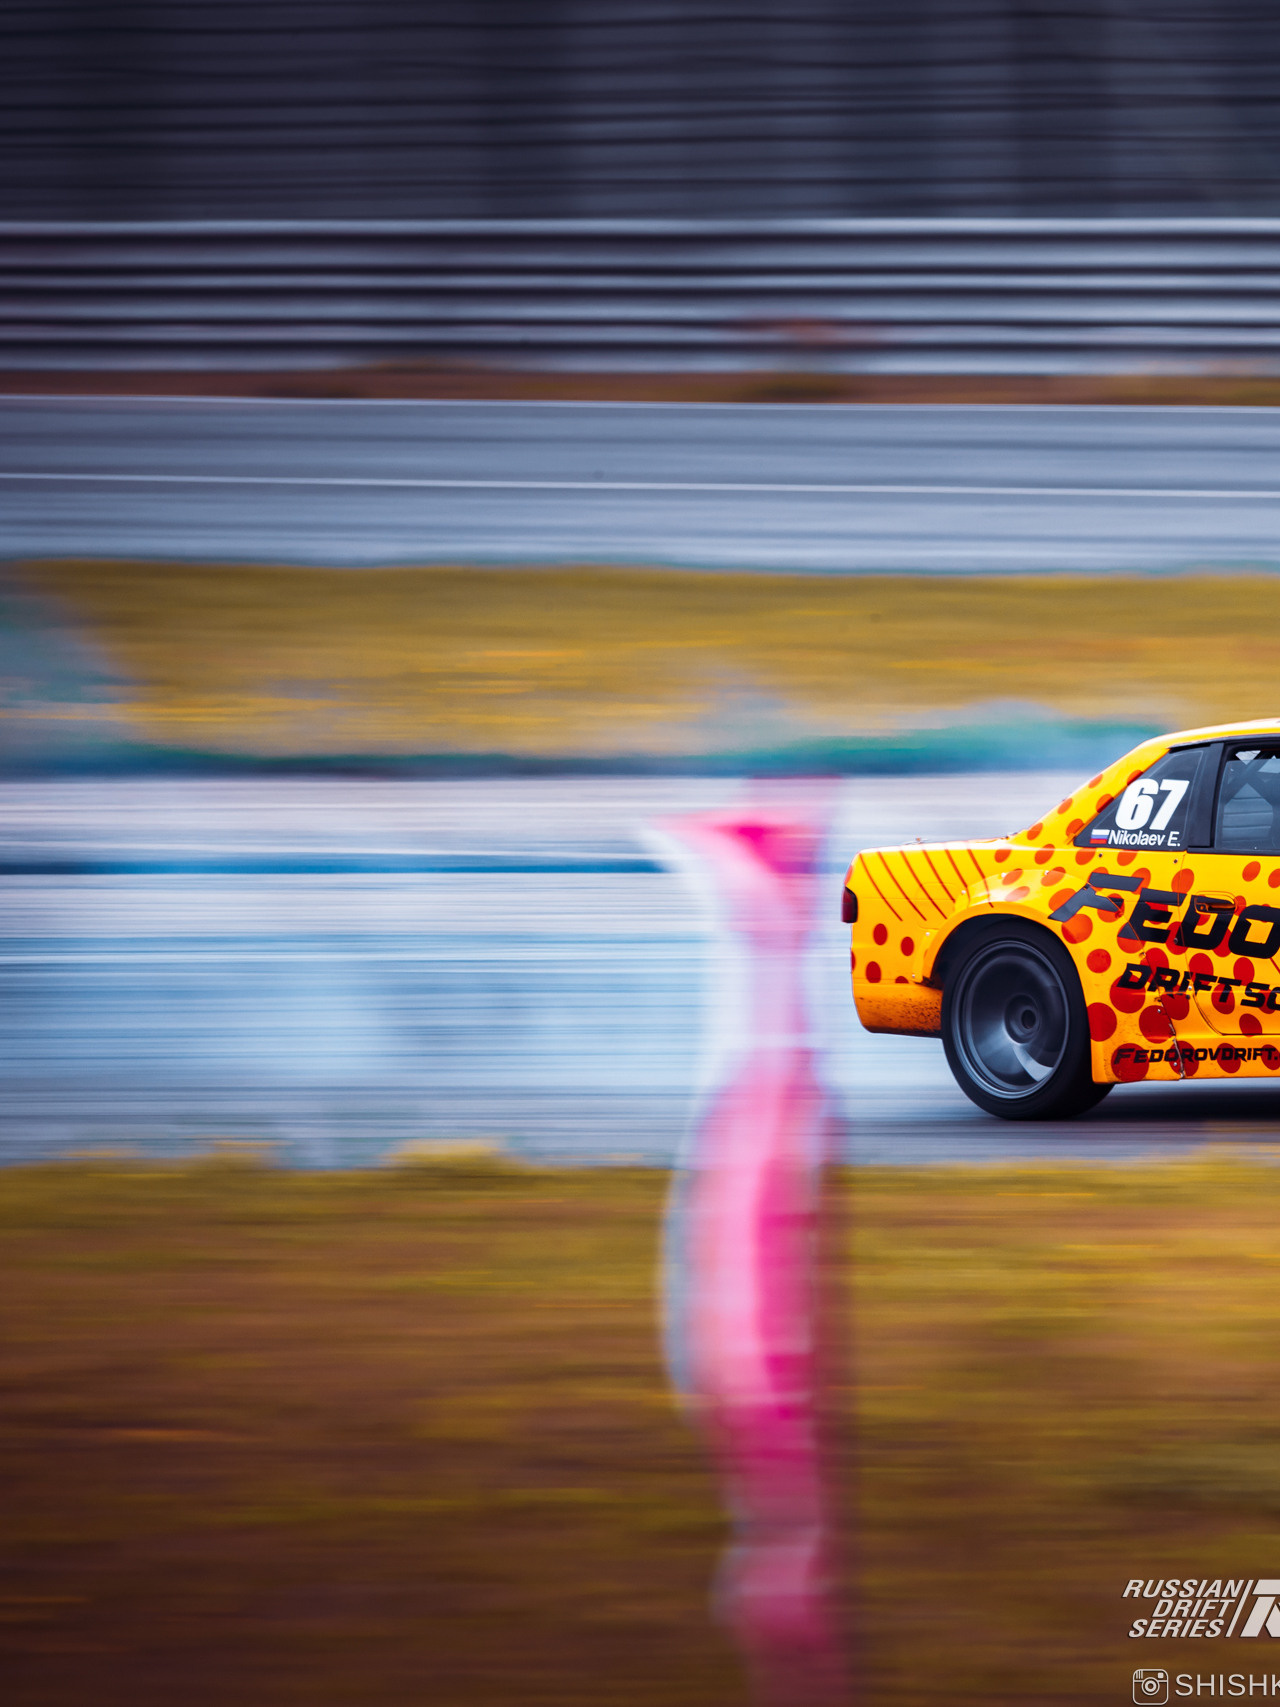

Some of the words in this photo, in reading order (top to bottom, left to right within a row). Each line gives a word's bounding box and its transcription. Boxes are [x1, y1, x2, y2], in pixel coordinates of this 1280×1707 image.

[1115, 778, 1190, 831] 67
[1108, 829, 1166, 846] Nikolaev
[1167, 831, 1181, 847] E.
[1116, 962, 1242, 1004] DRIFT
